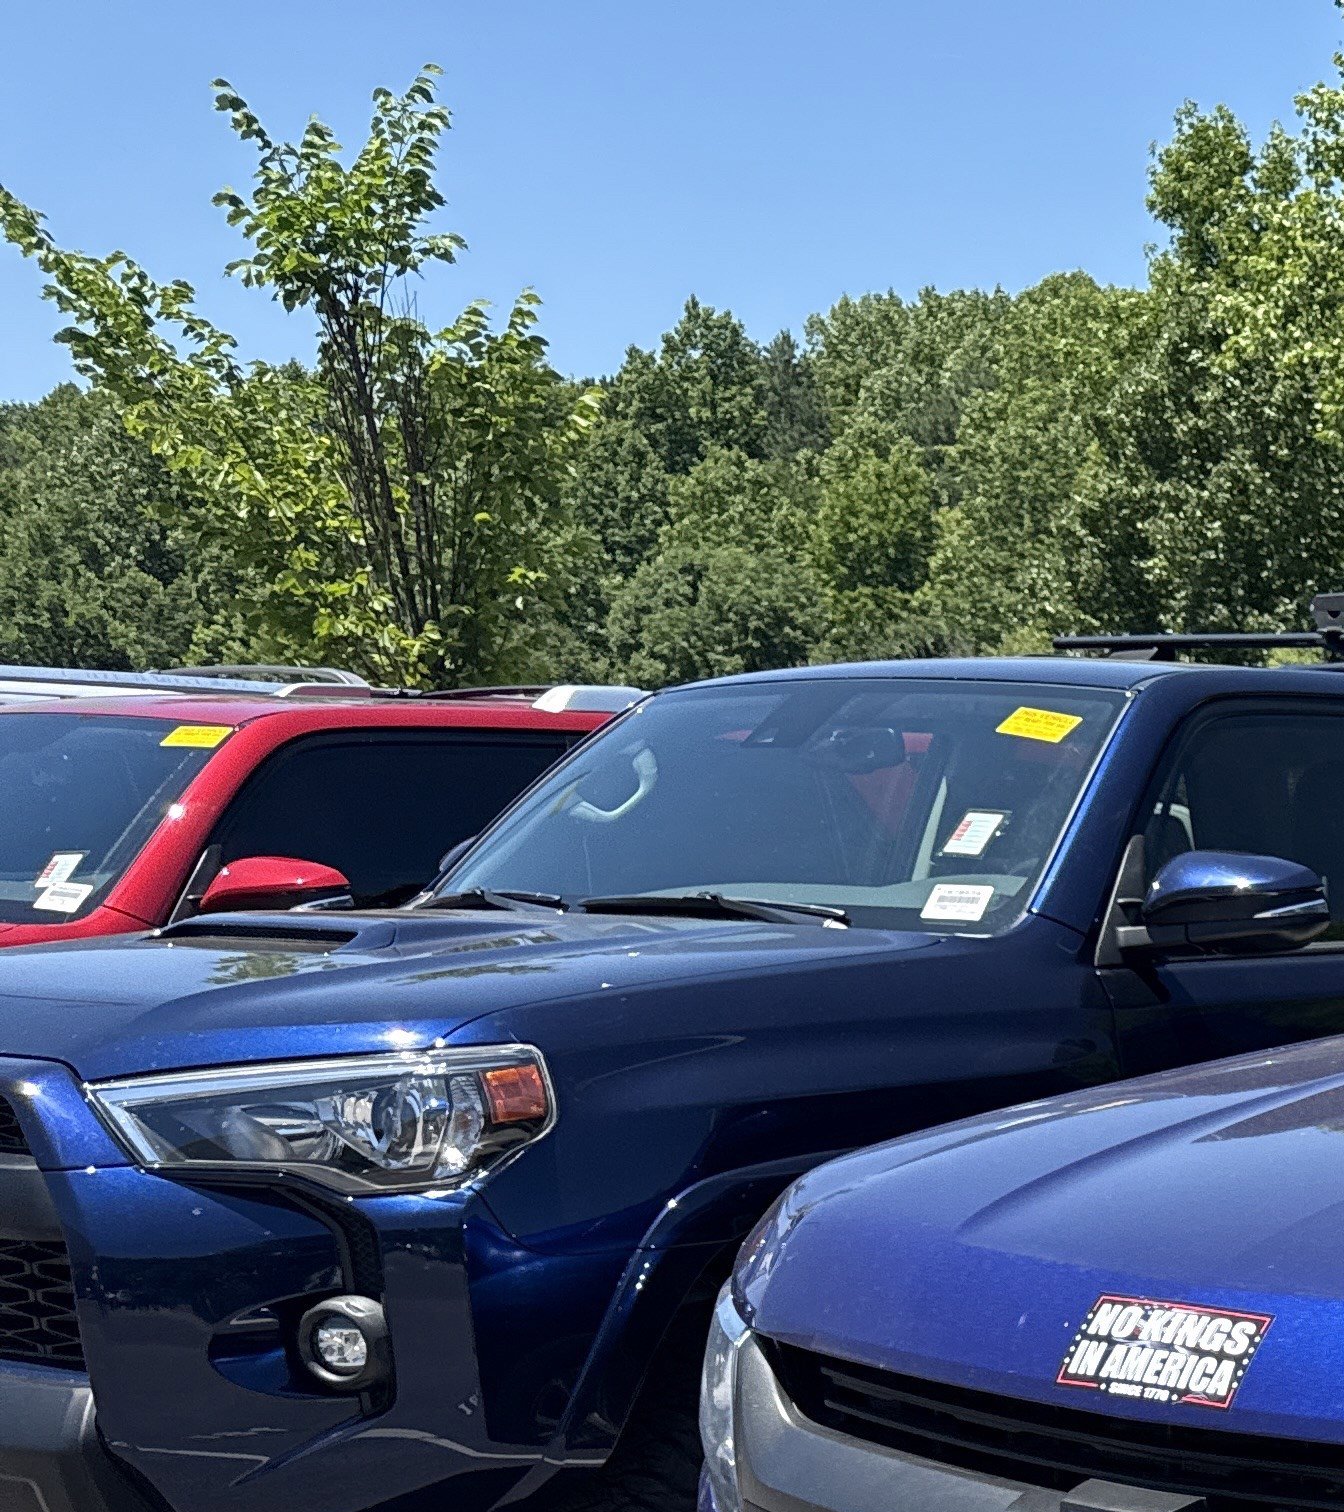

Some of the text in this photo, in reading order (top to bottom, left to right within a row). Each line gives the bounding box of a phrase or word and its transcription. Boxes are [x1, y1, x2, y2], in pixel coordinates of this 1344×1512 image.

[1087, 1303, 1257, 1355] NO KINGS
[1067, 1339, 1236, 1396] IN AMERICA
